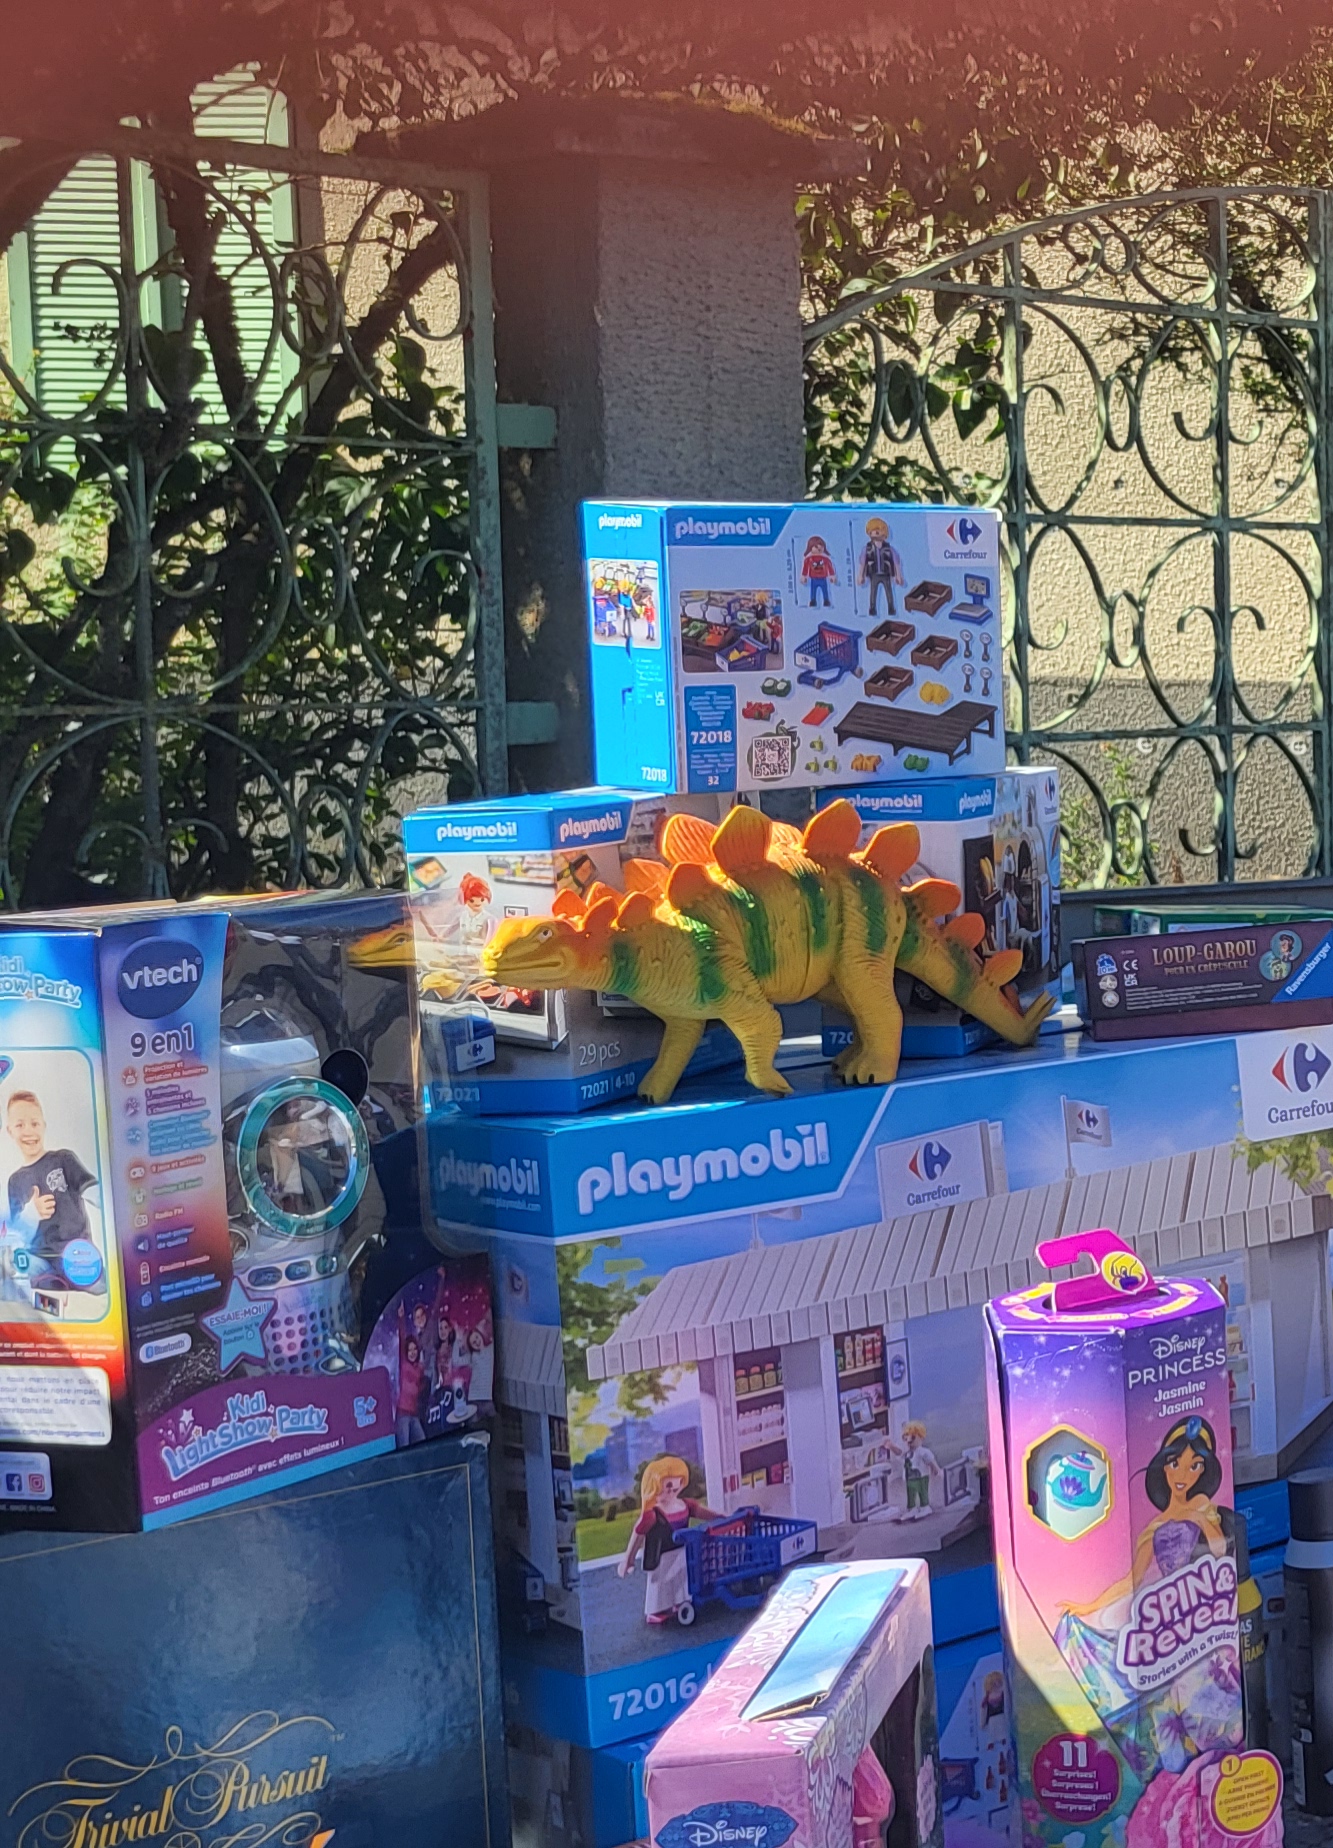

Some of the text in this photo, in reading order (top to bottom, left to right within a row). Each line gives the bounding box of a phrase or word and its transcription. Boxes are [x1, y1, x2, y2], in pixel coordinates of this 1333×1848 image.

[598, 513, 643, 530] playmobil
[674, 517, 771, 539] playmobil
[943, 549, 988, 561] Carrefour
[691, 730, 732, 745] 72018
[641, 766, 668, 783] 72018
[707, 775, 719, 785] 32
[848, 794, 923, 811] playmobil
[959, 789, 993, 814] playmobil
[437, 821, 518, 842] playmobil
[559, 811, 623, 842] playmobil
[1152, 939, 1258, 967] LOUP-GAROU
[122, 959, 199, 990] vtech
[1284, 941, 1333, 997] Ravensburger
[34, 974, 82, 1000] Party
[131, 1032, 147, 1058] 9
[578, 1041, 621, 1067] 29 pcs
[580, 1072, 635, 1099] 72021 4-10
[438, 1150, 541, 1197] playmobil
[576, 1120, 830, 1217] playmobil
[905, 1181, 962, 1208] Carrefour
[210, 1304, 260, 1326] ESSAIE-MOI
[1149, 1335, 1206, 1360] Disney
[1128, 1348, 1226, 1391] PRINCESS
[228, 1391, 266, 1420] Kidi
[1154, 1381, 1207, 1403] Jasmine
[277, 1405, 328, 1433] Party
[353, 1397, 377, 1416] 5+
[303, 1440, 340, 1458] lumineux
[1138, 1560, 1236, 1633] SPIN &
[1124, 1592, 1239, 1668] Reveal
[1138, 1661, 1178, 1687] Stories
[1178, 1647, 1199, 1667] with
[1207, 1628, 1239, 1648] Twist!
[607, 1671, 699, 1721] 72016
[1060, 1740, 1088, 1768] 11
[185, 1755, 330, 1824] Pursuit
[45, 1784, 176, 1848] Trivial
[683, 1819, 768, 1847] Disney
